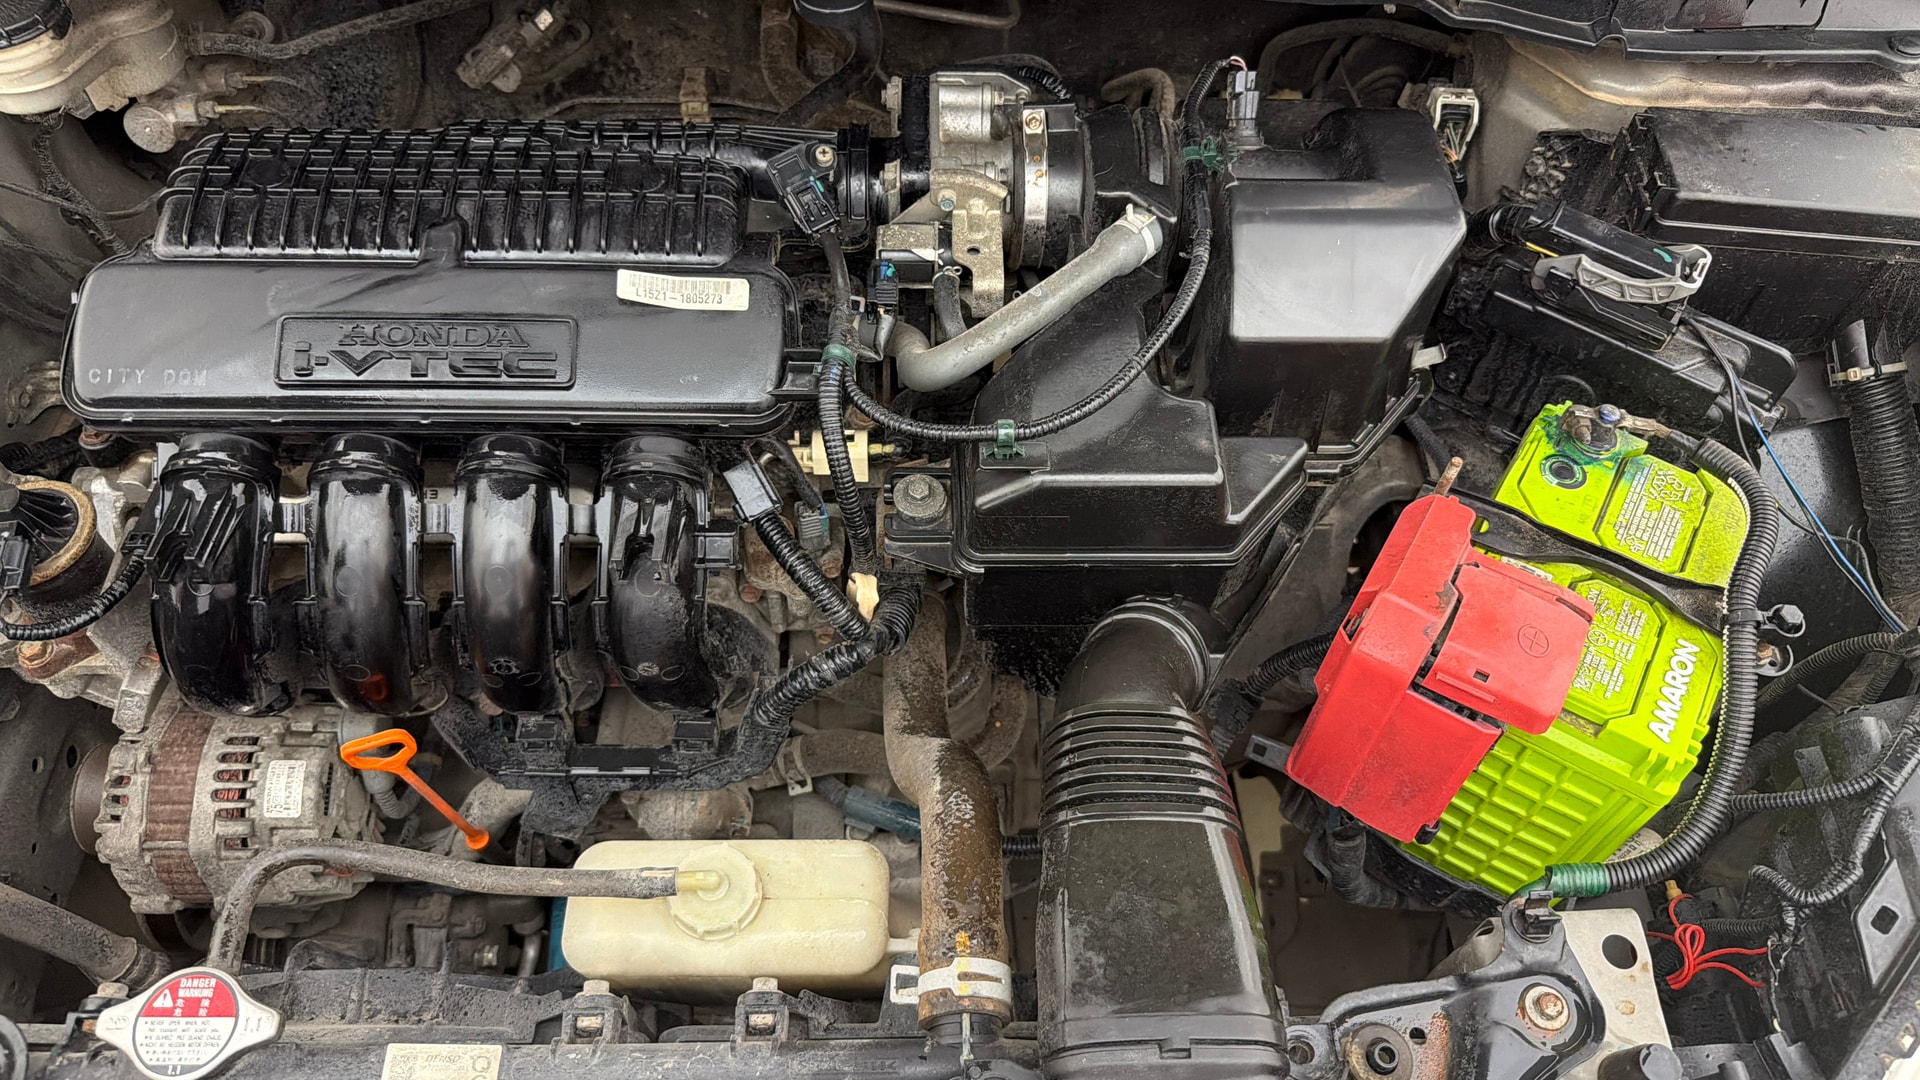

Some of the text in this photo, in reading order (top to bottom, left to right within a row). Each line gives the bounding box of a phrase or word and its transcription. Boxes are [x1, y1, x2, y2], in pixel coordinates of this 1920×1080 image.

[338, 324, 529, 348] HONDA
[293, 341, 557, 378] i-VTEC
[88, 368, 145, 384] CITY
[1648, 639, 1700, 743] AMARON
[180, 978, 217, 988] DANGER
[167, 1064, 182, 1075] 1.1
